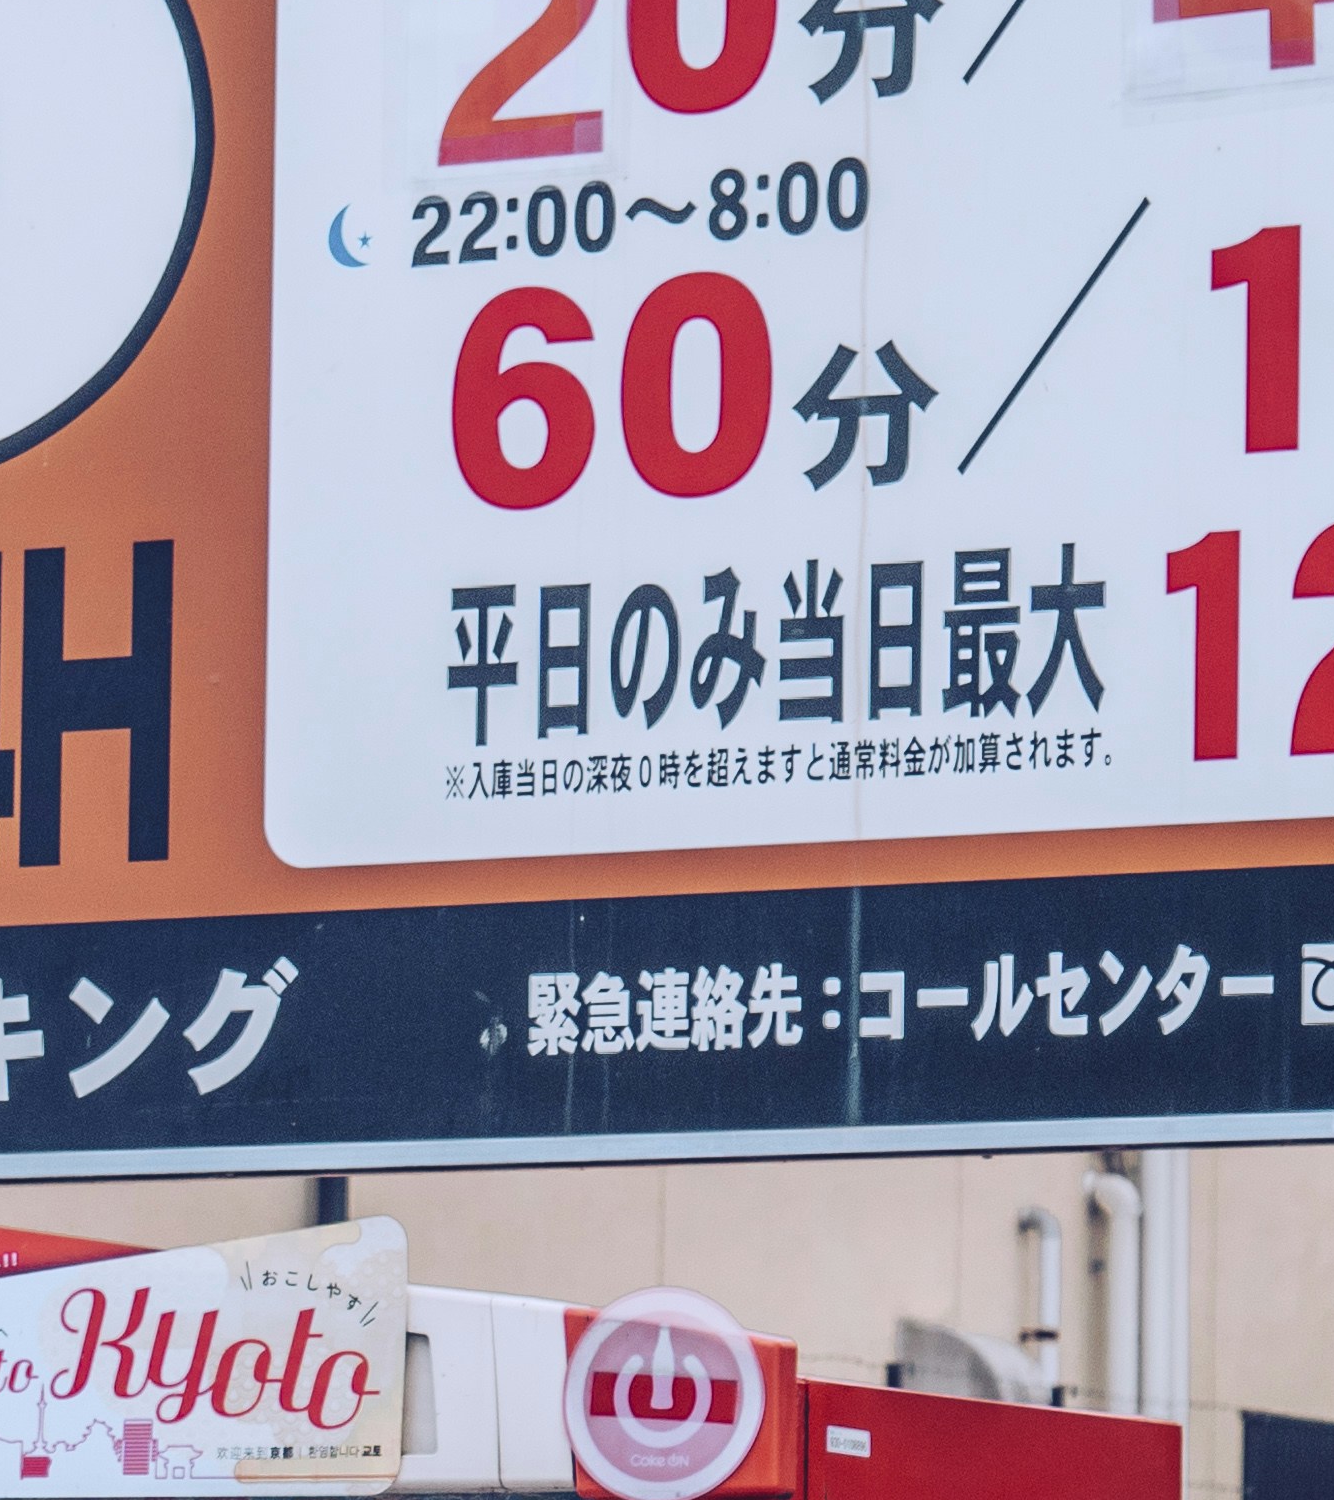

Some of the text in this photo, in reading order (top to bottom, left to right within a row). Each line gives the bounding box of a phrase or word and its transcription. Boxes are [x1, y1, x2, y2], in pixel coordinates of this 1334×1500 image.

[262, 1270, 362, 1311] おこしやす
[51, 1287, 380, 1431] Kyoto
[630, 1452, 664, 1468] Coke
